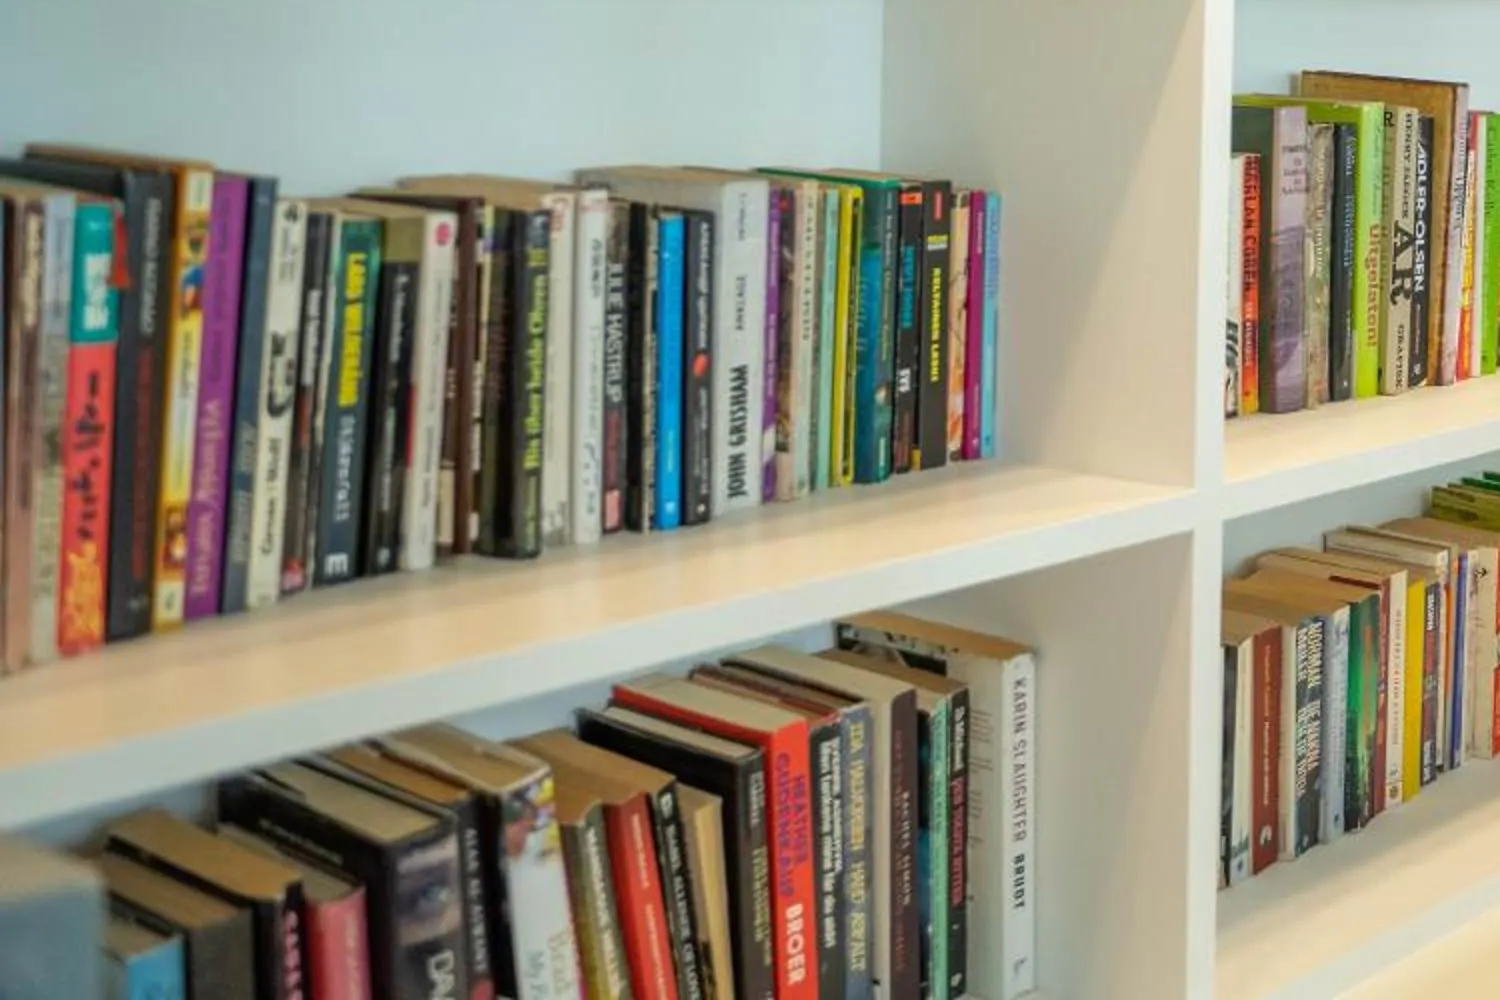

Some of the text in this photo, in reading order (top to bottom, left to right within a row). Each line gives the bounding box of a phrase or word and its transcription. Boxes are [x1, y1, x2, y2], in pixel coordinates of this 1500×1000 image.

[1402, 112, 1413, 163] HENRY
[1413, 143, 1429, 293] ADLER-OLSEN
[528, 274, 548, 334] Ohren
[605, 261, 624, 310] JULIE
[526, 337, 544, 389] beide
[605, 313, 624, 403] HASTRUP
[728, 363, 749, 498] JOHN GRISHAM
[1307, 621, 1323, 690] NORMAN
[848, 720, 866, 755] IDA
[951, 722, 965, 772] Michael
[1011, 678, 1027, 844] KARIN SLAUGHTER
[792, 774, 809, 865] HEATHER
[901, 790, 912, 906] RACHEL SIMON
[671, 875, 691, 941] ALLENDE
[1012, 853, 1026, 911] BRUDT
[427, 949, 457, 1000] DA
[784, 902, 805, 985] BROER
